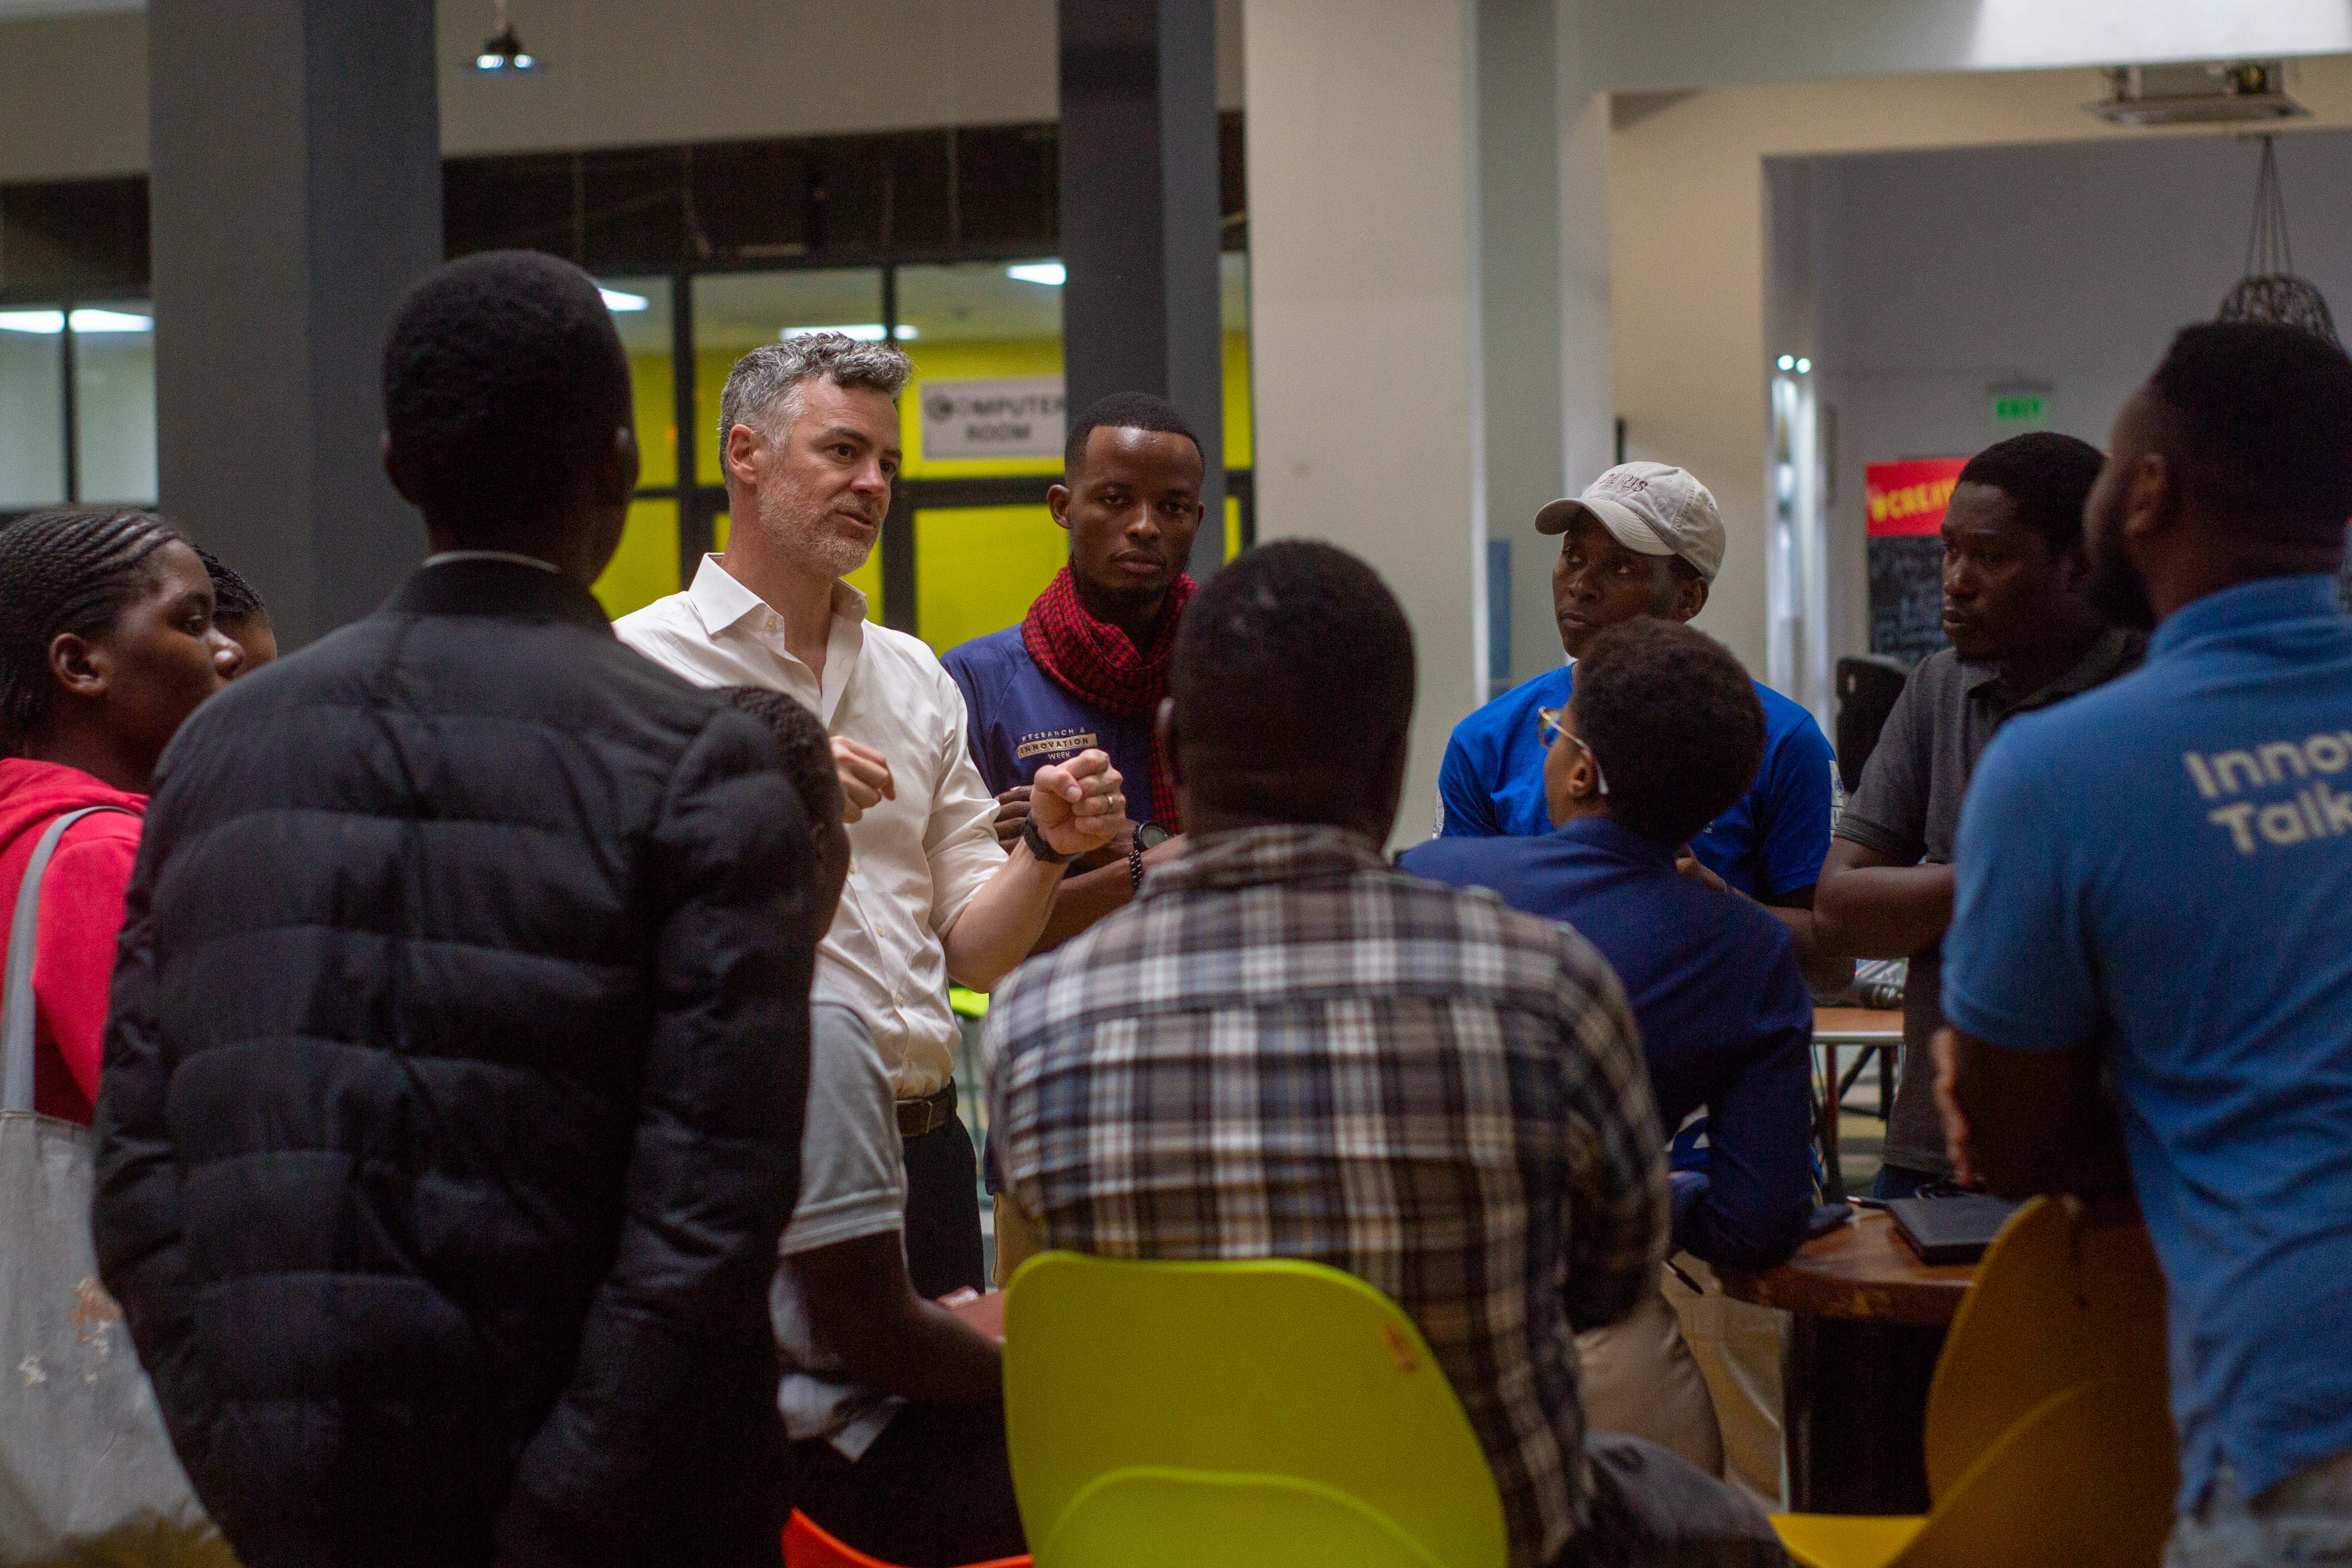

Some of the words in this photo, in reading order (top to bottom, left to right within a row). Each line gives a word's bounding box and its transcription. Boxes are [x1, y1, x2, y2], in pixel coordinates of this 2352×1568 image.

[966, 424, 1030, 441] ROOM
[1021, 728, 1074, 742] RESEARCH
[1020, 737, 1089, 754] INNOVATION
[1048, 751, 1071, 760] WEEK
[2183, 731, 2352, 799] Inno
